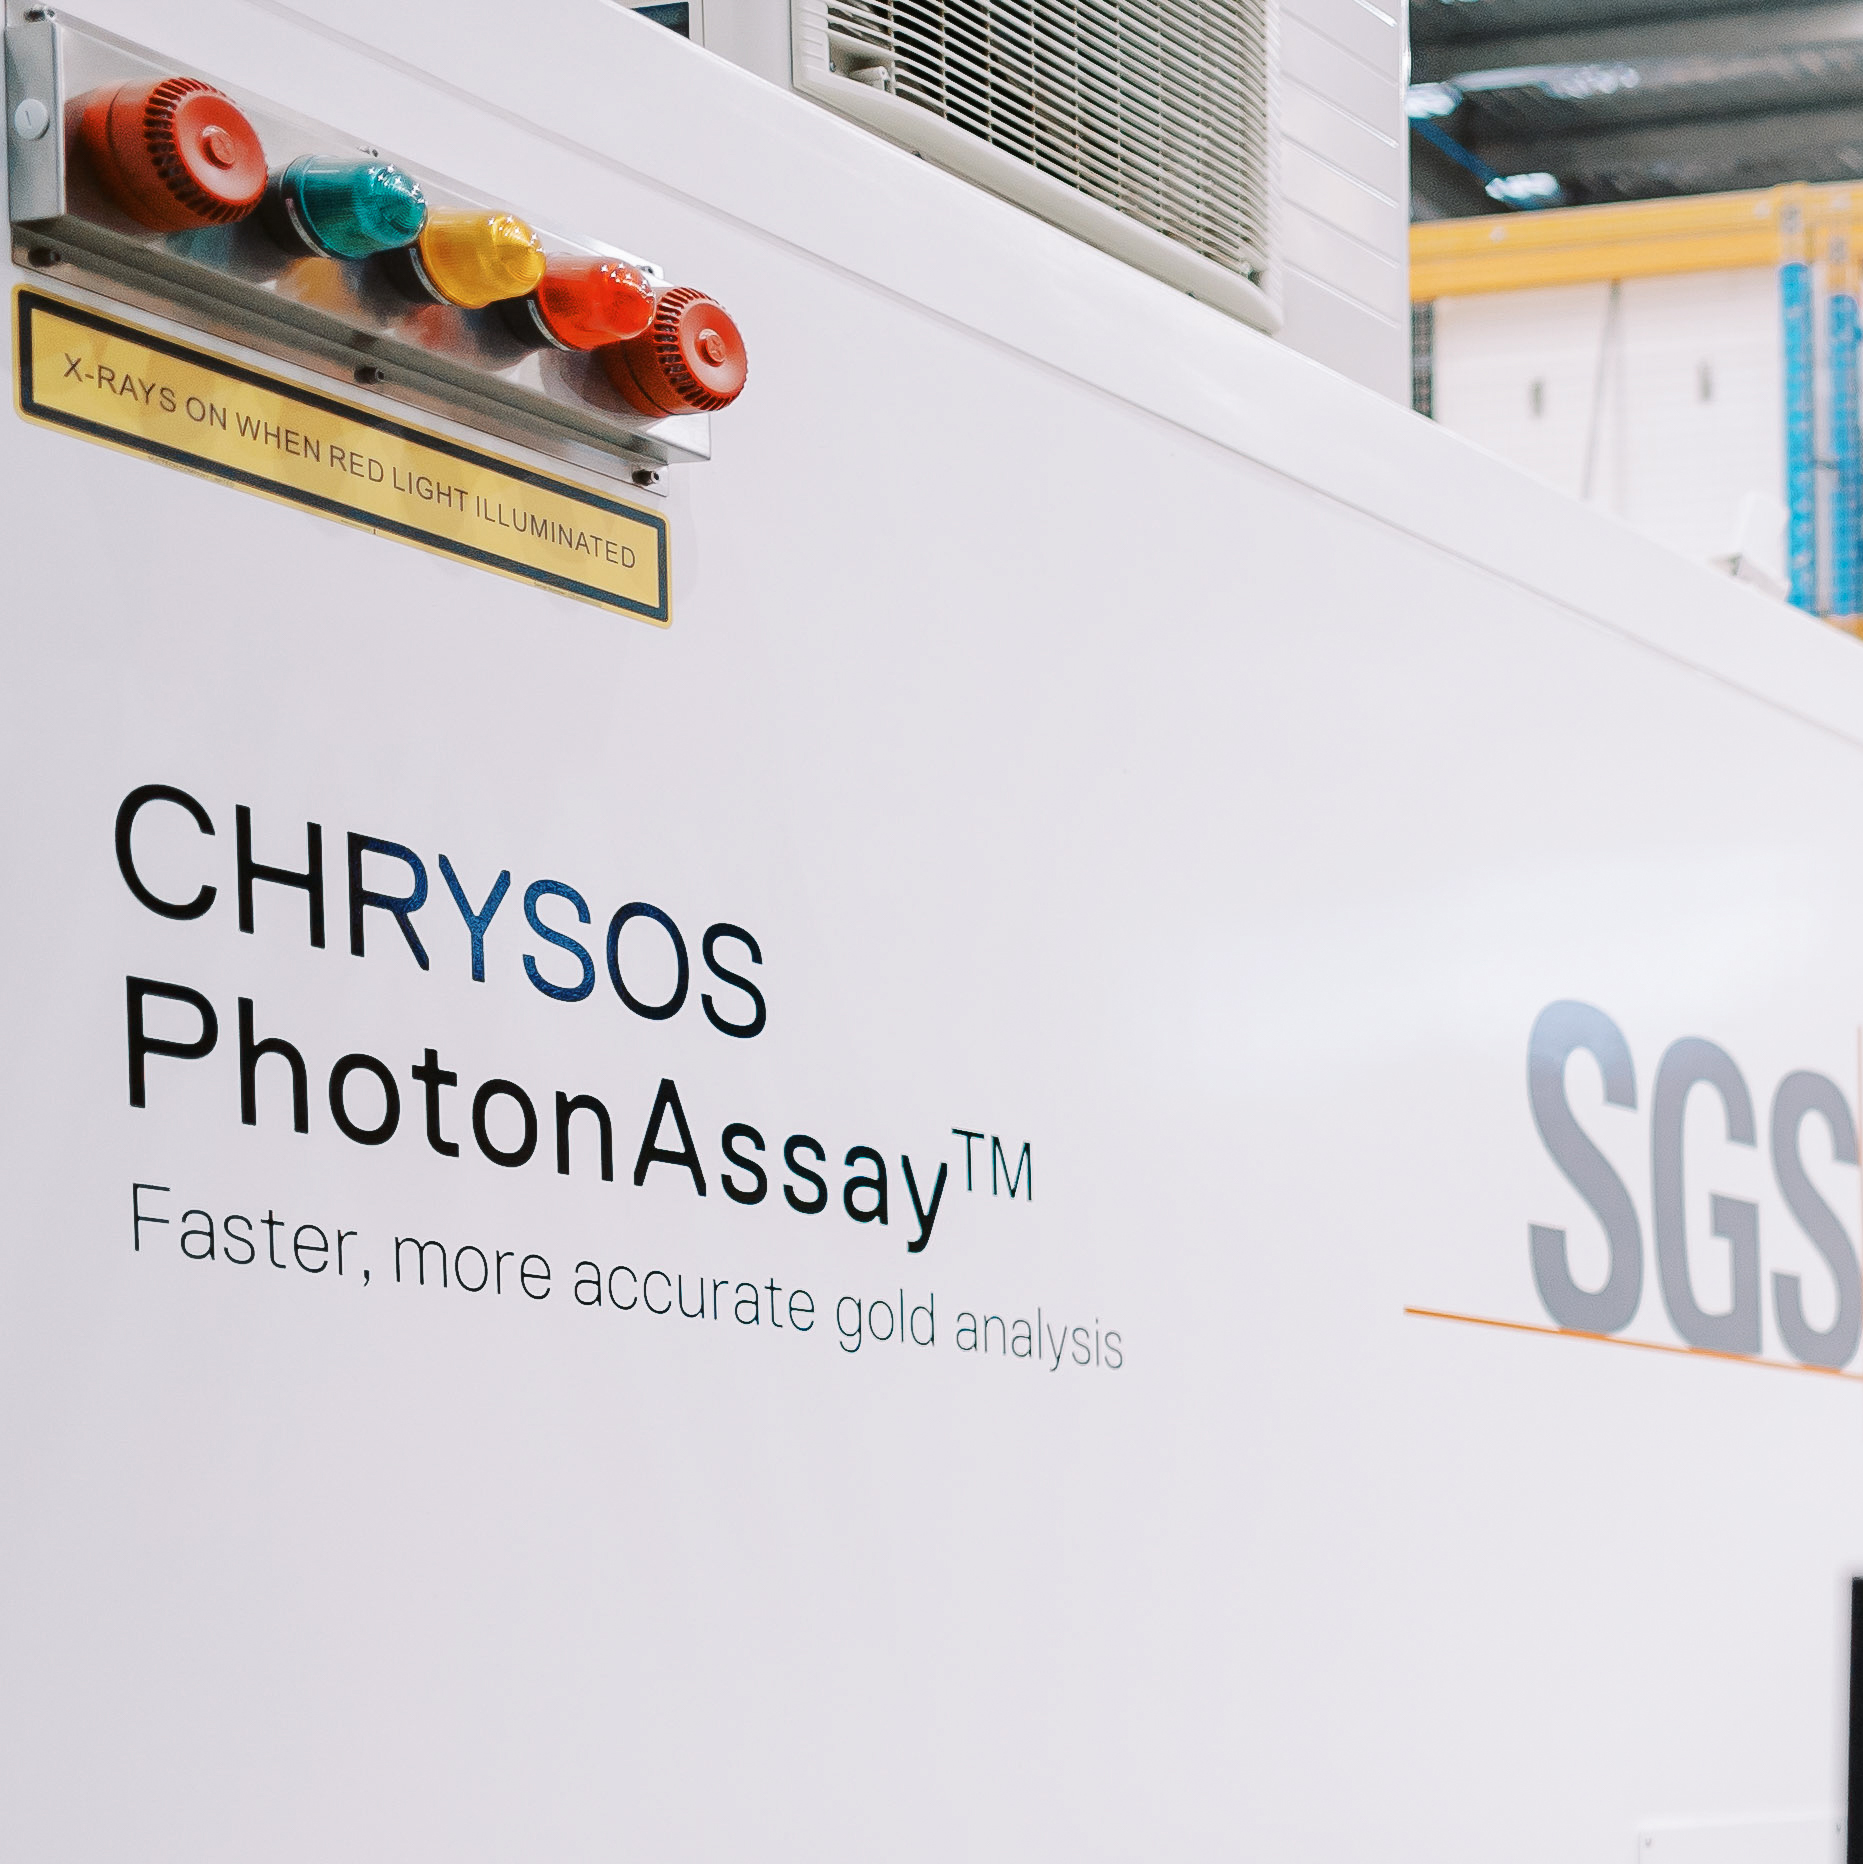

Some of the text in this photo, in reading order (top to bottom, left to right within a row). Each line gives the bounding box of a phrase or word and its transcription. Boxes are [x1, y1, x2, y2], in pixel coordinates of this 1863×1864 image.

[63, 352, 636, 569] X-RAYS ON WHEN RED LIGHT ILLUMINATED
[114, 783, 767, 1040] CHRYSOS
[131, 1181, 1125, 1373] Faster, more accurate gold analysis
